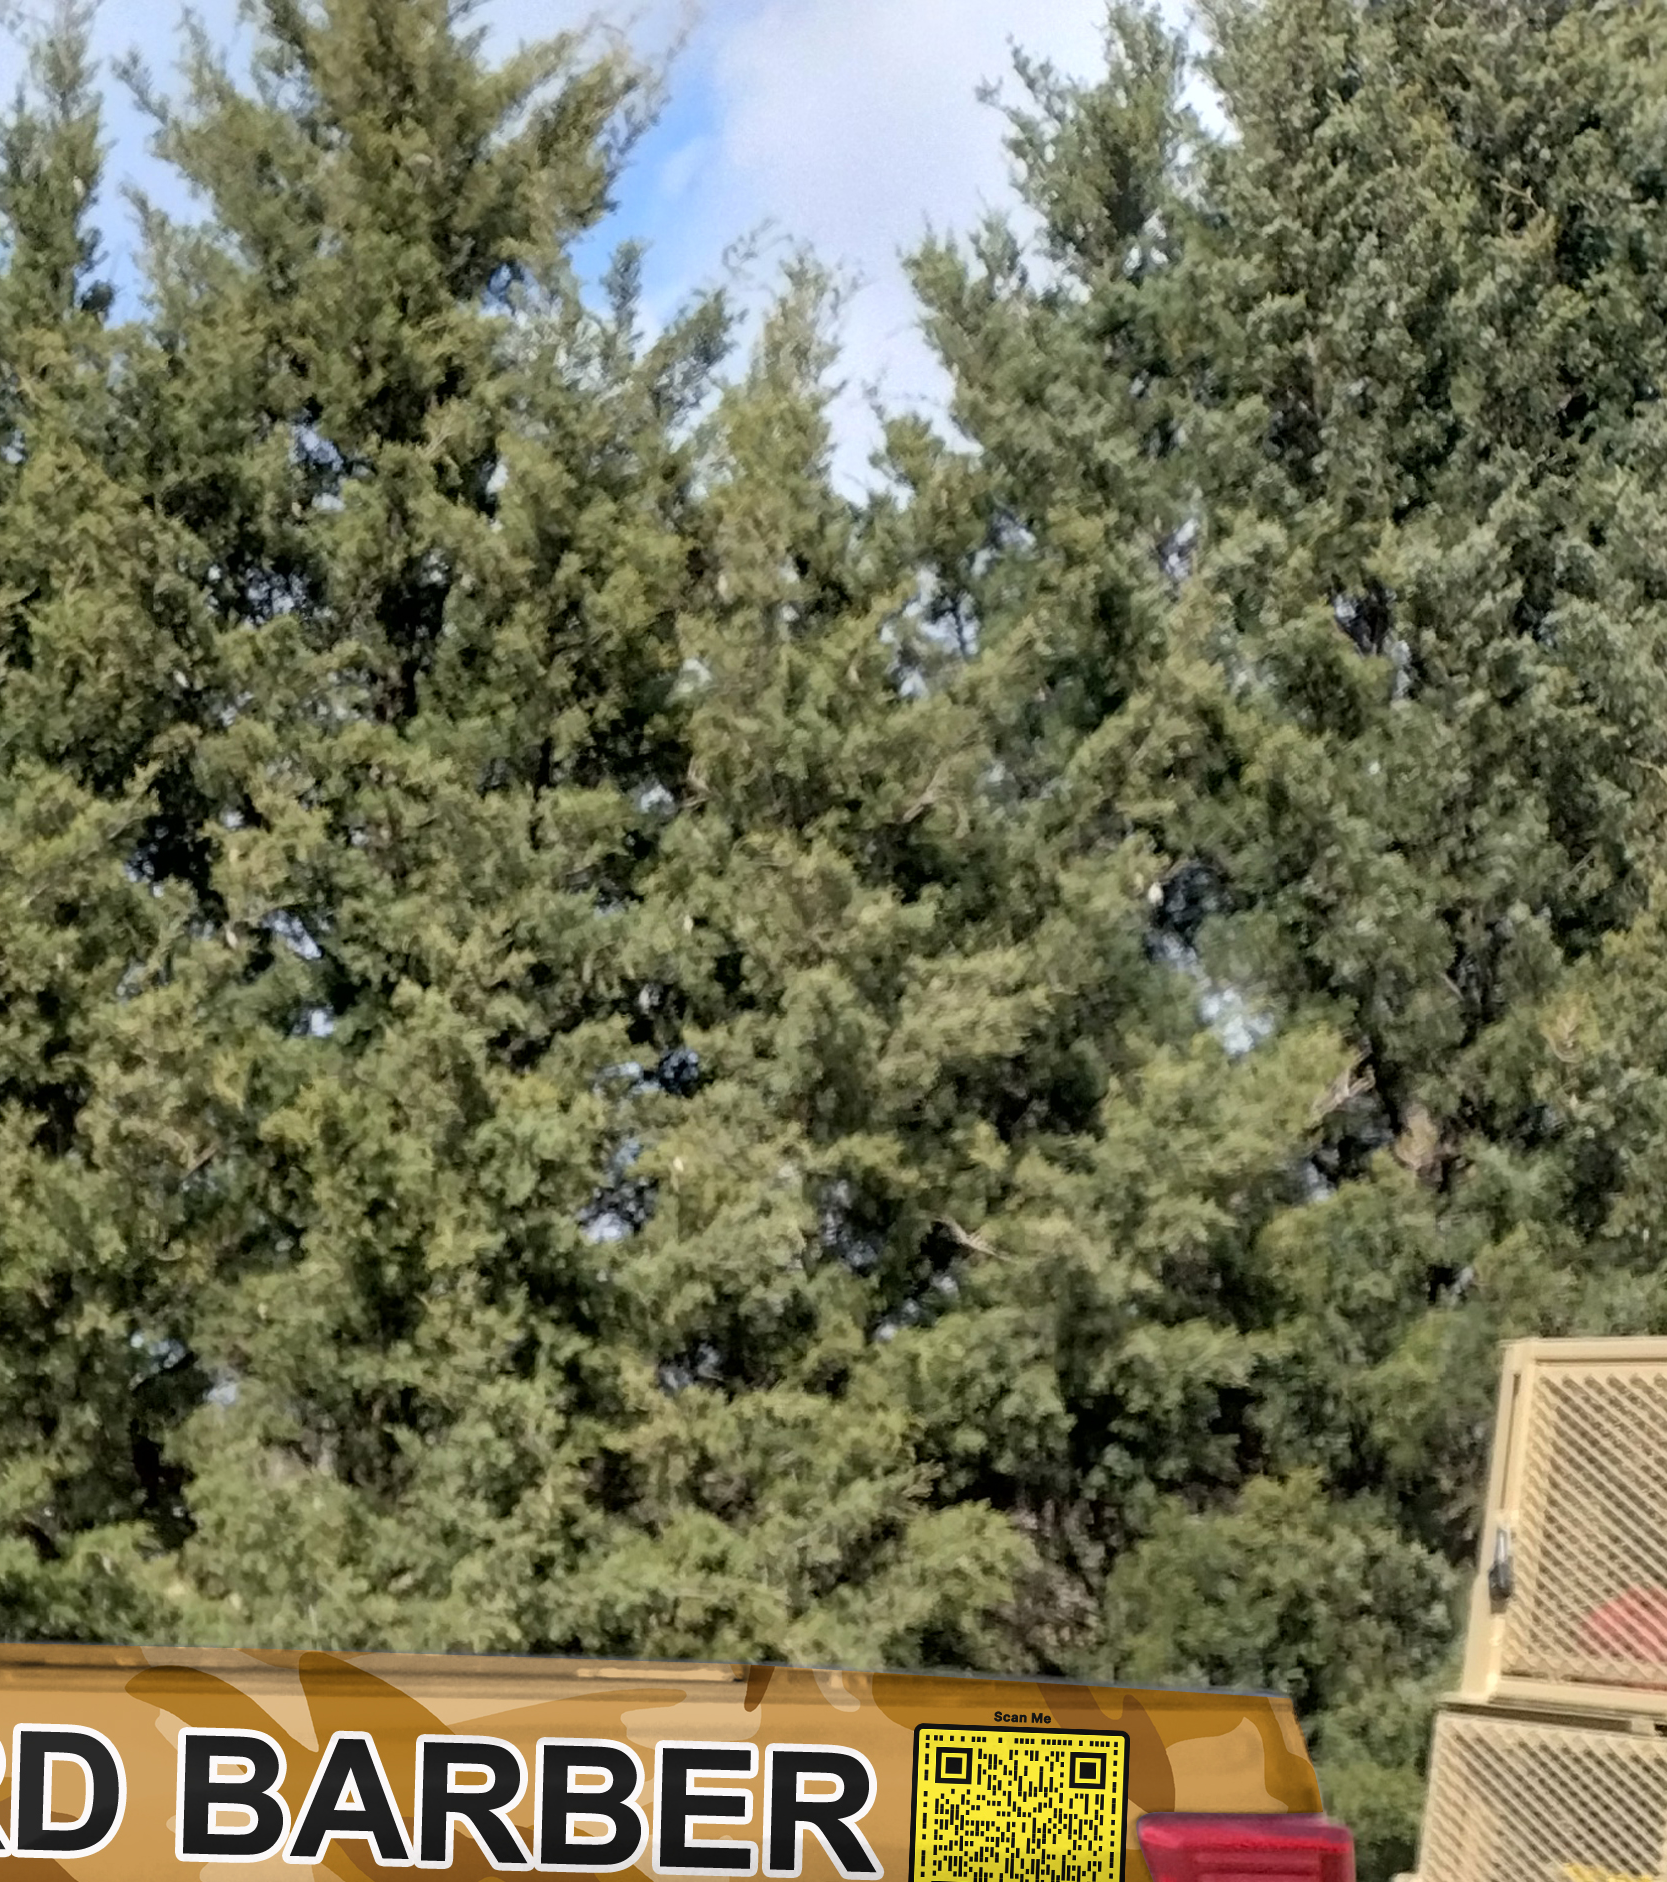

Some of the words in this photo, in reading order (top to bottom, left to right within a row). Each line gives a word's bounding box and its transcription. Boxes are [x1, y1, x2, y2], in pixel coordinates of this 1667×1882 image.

[994, 1711, 1027, 1723] Scan
[1031, 1713, 1052, 1724] Me
[175, 1727, 885, 1880] BARBER
